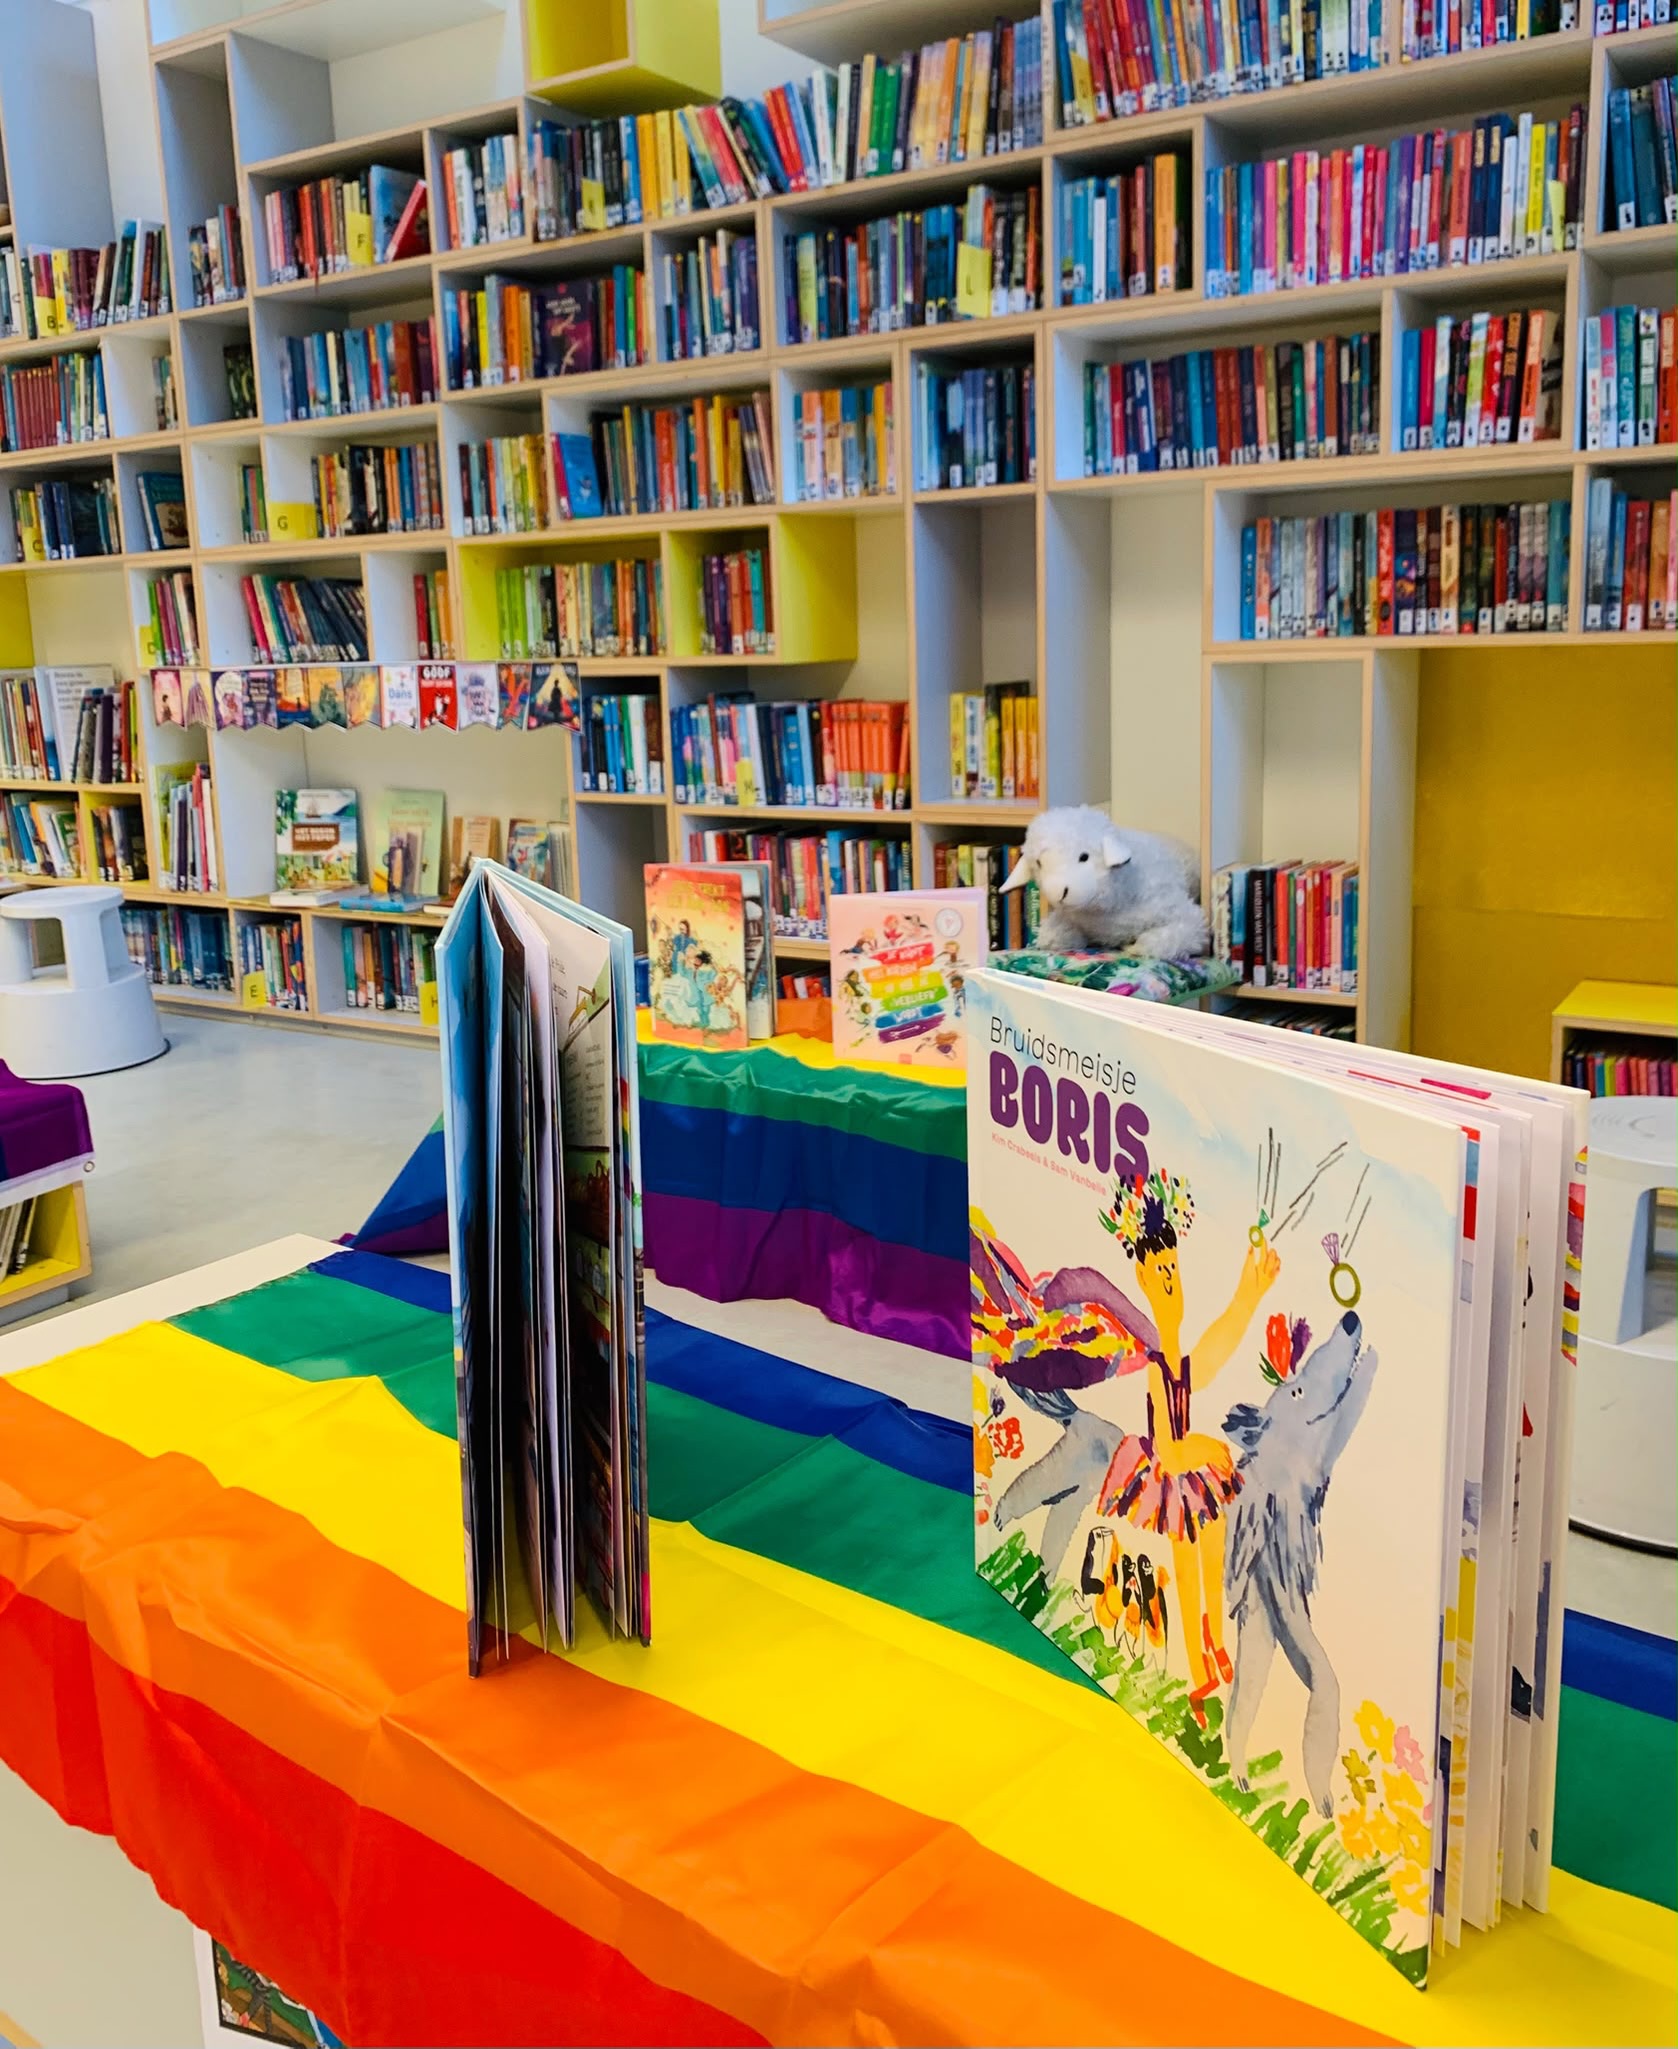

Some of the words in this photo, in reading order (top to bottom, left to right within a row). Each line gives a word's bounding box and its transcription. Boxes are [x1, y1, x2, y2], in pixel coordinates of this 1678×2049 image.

[47, 316, 57, 329] B
[277, 515, 288, 531] G
[249, 984, 257, 998] E
[990, 1016, 1137, 1095] Bruidsmeisje
[989, 1050, 1150, 1188] BORIS
[992, 1132, 1006, 1146] Kim
[1043, 1156, 1049, 1168] &
[1050, 1161, 1068, 1177] Sam
